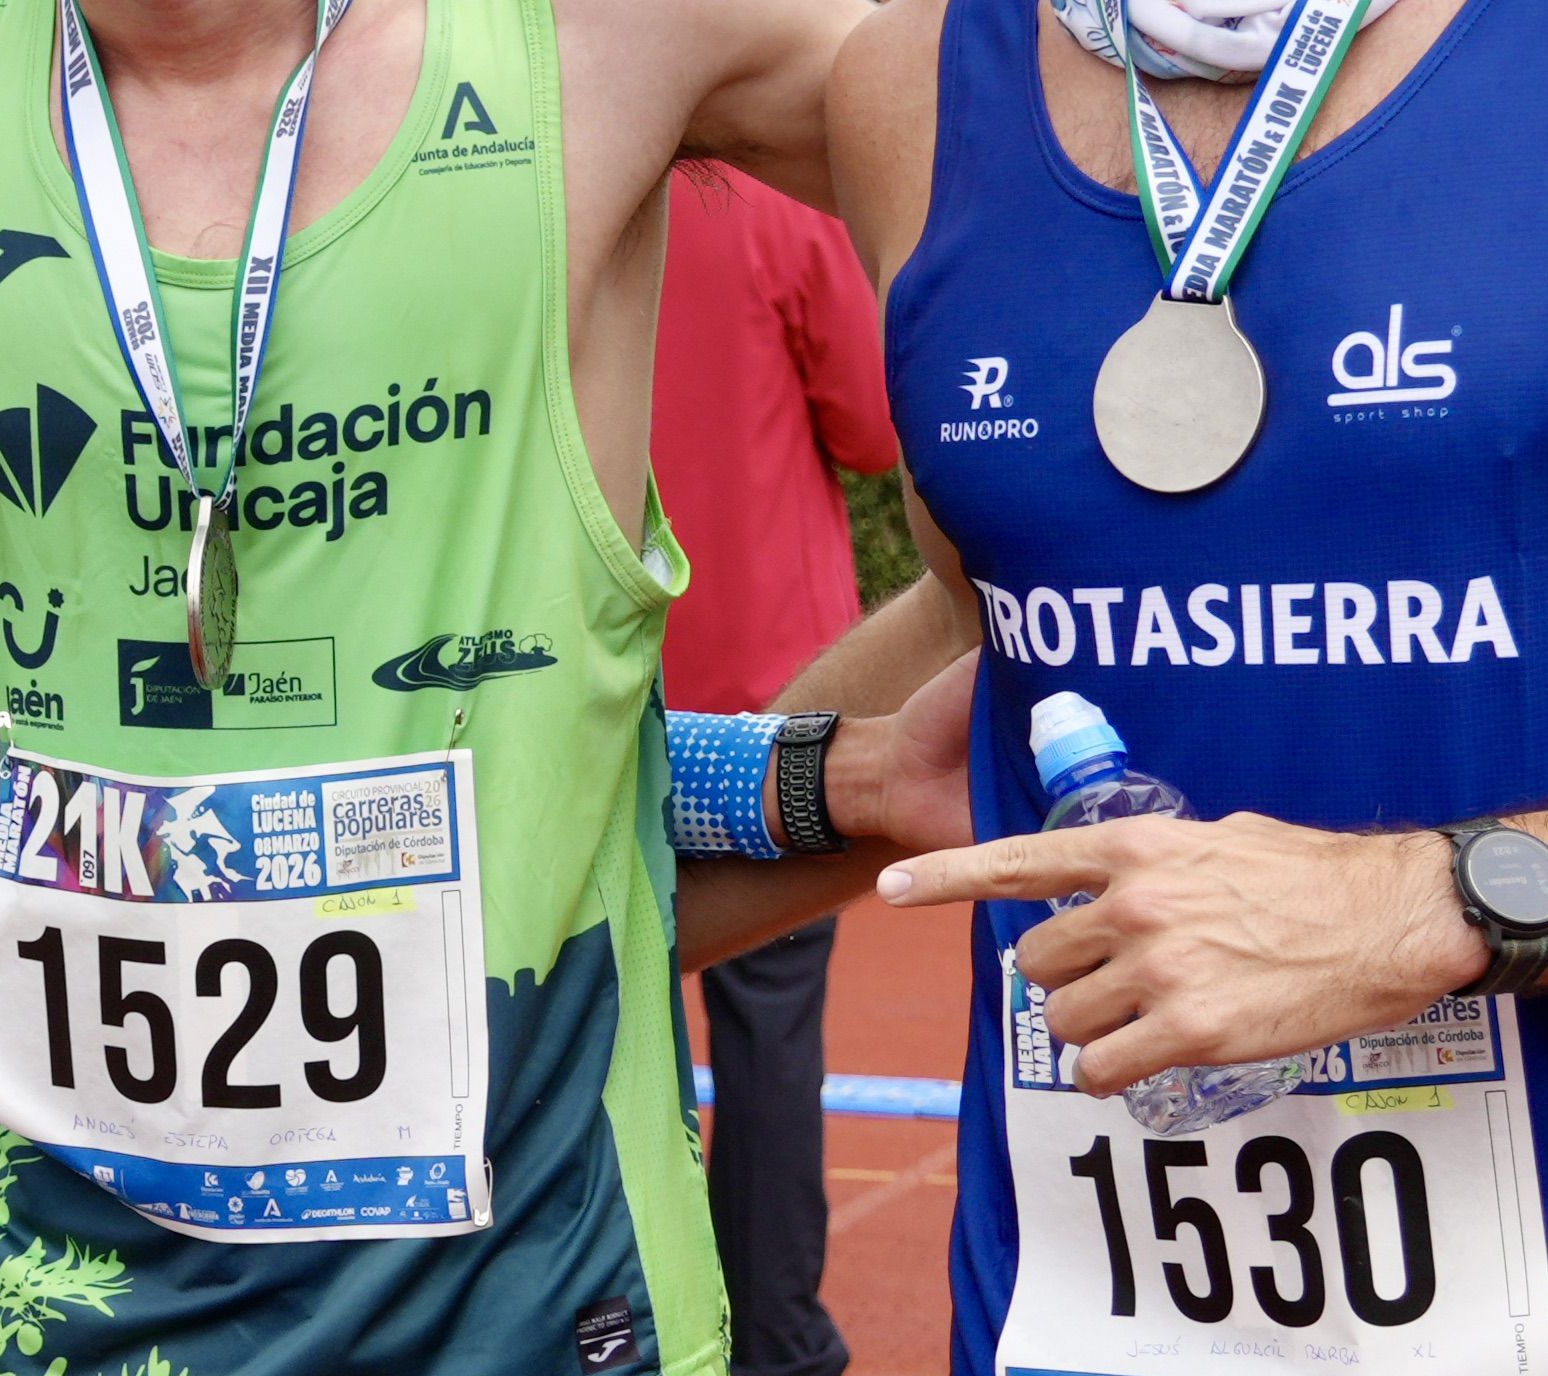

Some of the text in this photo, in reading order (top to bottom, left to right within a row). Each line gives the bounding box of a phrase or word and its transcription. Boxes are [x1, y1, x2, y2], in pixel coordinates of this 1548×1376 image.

[1284, 8, 1324, 69] Ciudad de
[1298, 14, 1343, 77] LUCENA
[67, 51, 92, 99] XII
[275, 96, 300, 139] 2026
[452, 144, 469, 158] de
[471, 136, 536, 156] Andalucía
[1135, 108, 1191, 216] MARATÓN
[1203, 81, 1307, 251] MARATÓN & 10K
[1162, 214, 1176, 227] &
[132, 300, 156, 346] 2026
[239, 254, 274, 369] XII MEDIA
[1333, 405, 1449, 425] sport shop
[971, 575, 1520, 667] TROTASIERRA
[248, 671, 302, 695] Jaén
[285, 692, 323, 702] INTERIOR
[251, 789, 316, 811] Ciudad de
[331, 781, 424, 802] CIRCUITO PROVINCIAL
[332, 792, 424, 821] carreras
[3, 764, 32, 874] MARATÓN
[18, 770, 155, 897] 21K
[252, 807, 317, 834] LUCENA
[334, 807, 443, 844] populares
[334, 833, 445, 858] Diputación de Córdoba
[255, 852, 322, 892] 2026
[391, 889, 403, 906] 1
[17, 924, 388, 1109] 1529
[1026, 981, 1053, 1084] MARATÓ
[1015, 1009, 1036, 1082] MEDIA
[1359, 1028, 1485, 1050] Diputación de Córdoba
[1427, 1085, 1441, 1108] 1
[269, 1128, 337, 1147] ORTEGA
[452, 1103, 463, 1151] TIEMPO
[311, 1206, 391, 1219] DECATHLON COVAP
[1068, 1129, 1438, 1330] 1530
[1412, 1344, 1438, 1359] XL
[1514, 1323, 1526, 1375] TIEMPO
